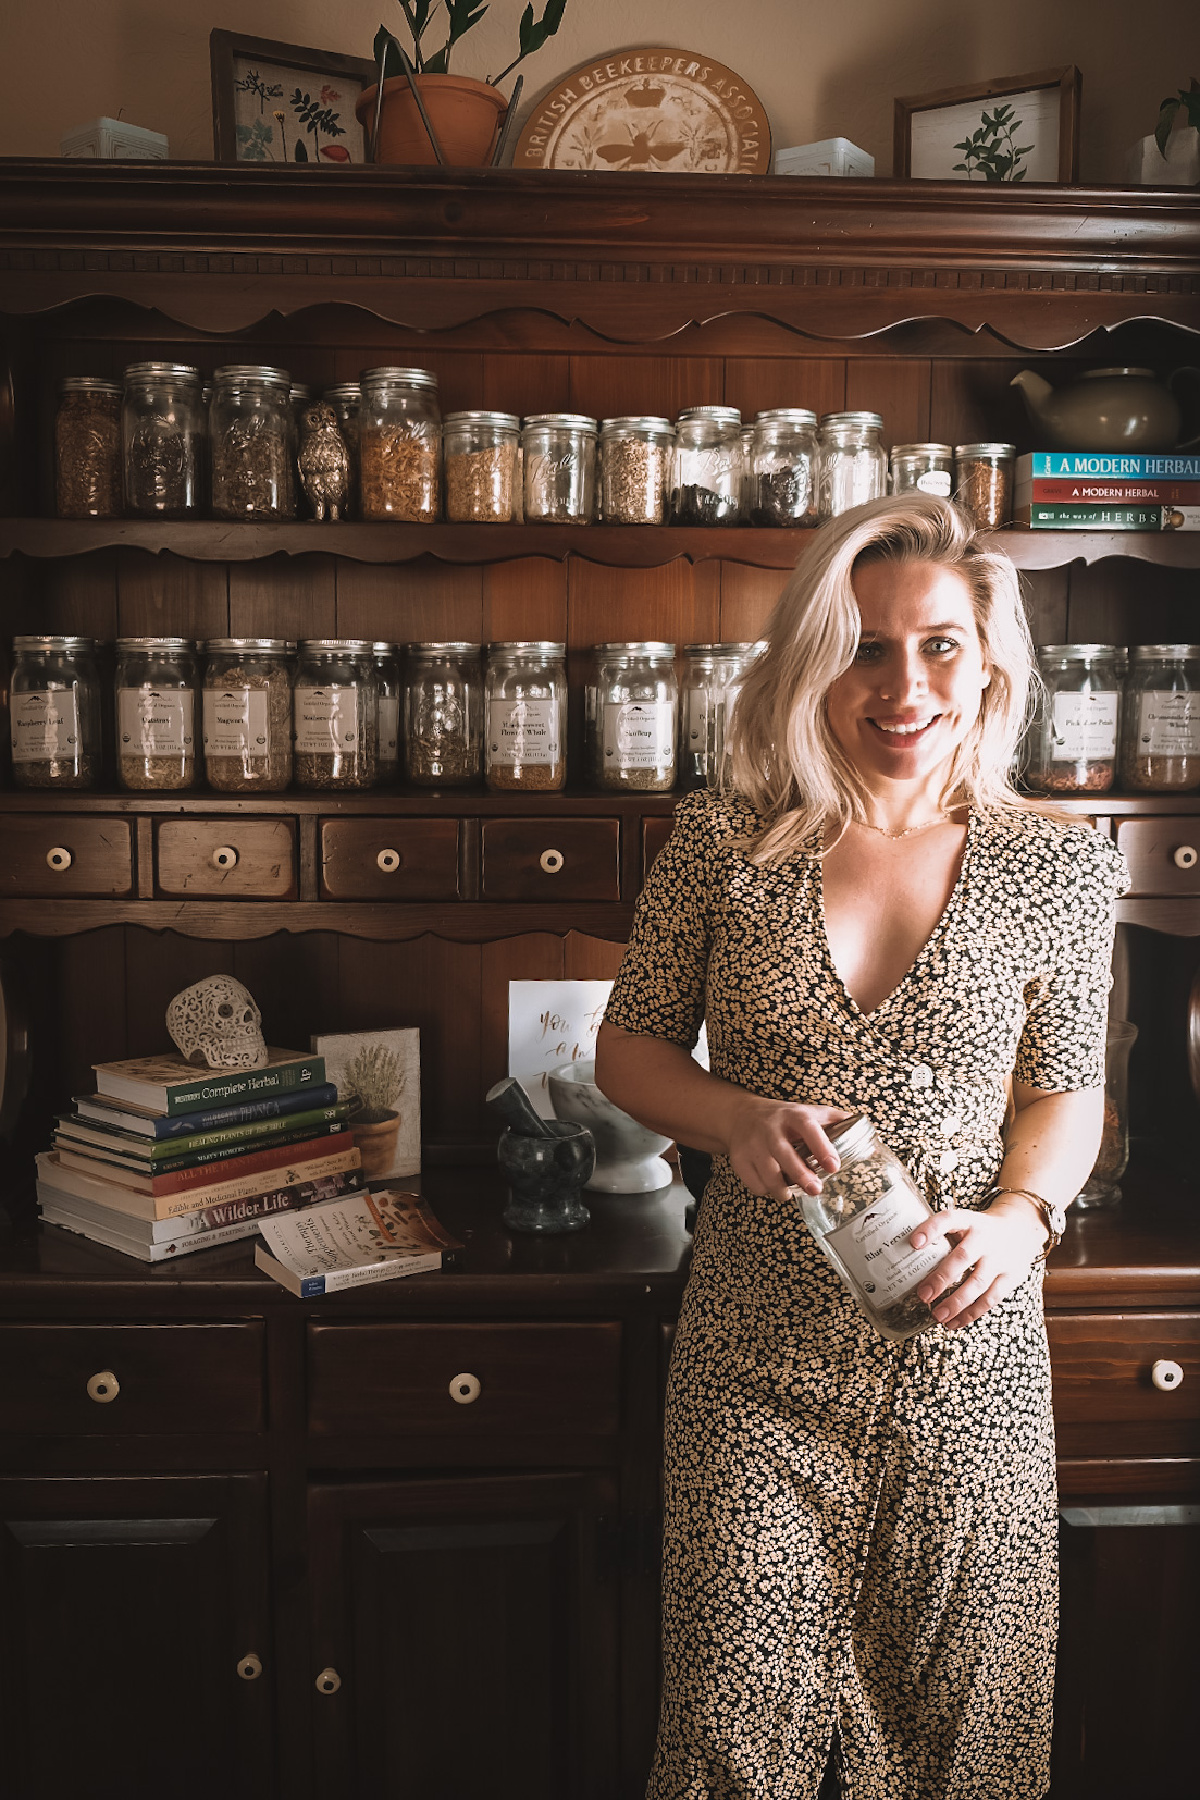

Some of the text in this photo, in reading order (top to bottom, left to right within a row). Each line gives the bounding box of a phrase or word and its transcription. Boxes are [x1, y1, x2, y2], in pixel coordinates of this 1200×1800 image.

[525, 87, 577, 158] BRITISH
[578, 56, 713, 90] BEEKEEPERS
[1060, 458, 1200, 474] A MODERN HERBAL
[1072, 488, 1159, 498] A MODERN HERBAL
[1089, 512, 1097, 520] of
[1101, 511, 1157, 523] HERBS
[201, 1082, 247, 1100] Complete
[247, 1073, 280, 1090] Herbal
[188, 1136, 219, 1148] HEALING
[220, 1131, 244, 1144] PLANTS
[245, 1128, 253, 1136] OF
[177, 1170, 197, 1182] ALL
[198, 1165, 218, 1177] THE
[220, 1155, 258, 1172] PLANTS
[168, 1202, 190, 1214] Edible
[190, 1198, 203, 1209] and
[205, 1189, 237, 1205] Medicinal
[237, 1185, 258, 1198] Plants
[212, 1202, 260, 1225] Wilder
[263, 1193, 290, 1212] Life
[855, 1211, 899, 1244] Certified Organic
[182, 1235, 211, 1248] FORAGING
[864, 1247, 884, 1263] Blue
[883, 1225, 914, 1248] Vervain
[882, 1281, 897, 1293] NET
[896, 1274, 908, 1285] WT
